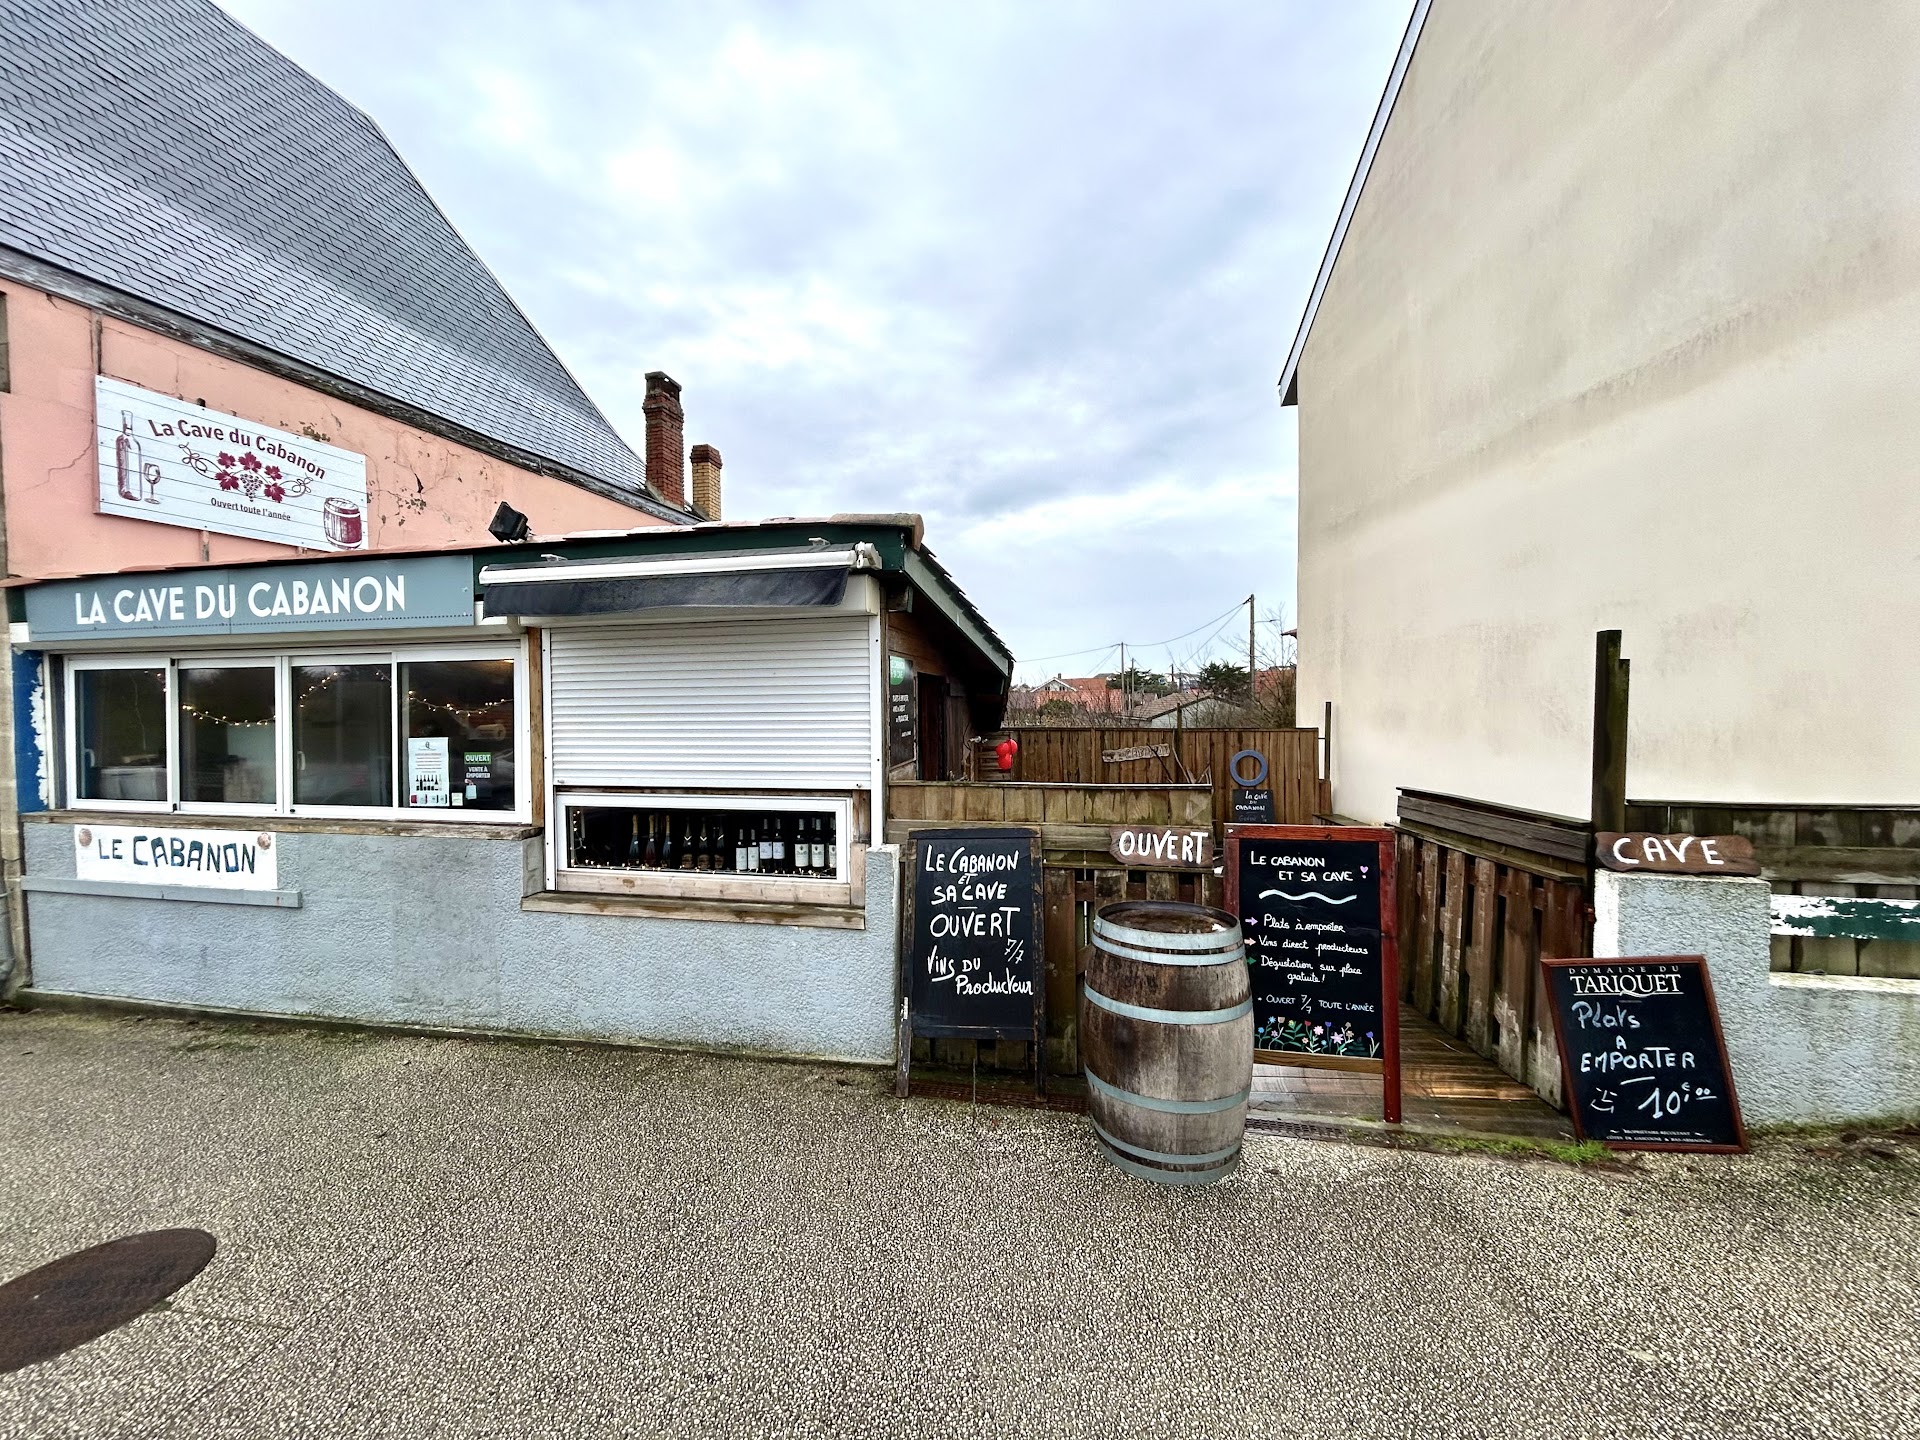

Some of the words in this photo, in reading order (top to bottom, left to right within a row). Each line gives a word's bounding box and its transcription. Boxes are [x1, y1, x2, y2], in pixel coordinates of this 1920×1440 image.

[148, 419, 174, 437] La
[178, 420, 224, 440] Cave
[229, 428, 250, 446] du
[256, 436, 326, 480] Cabanon
[211, 498, 239, 511] Ouvert
[240, 502, 261, 516] toute
[262, 502, 291, 521] l'année
[75, 593, 106, 625] LA
[114, 587, 184, 623] CAVE
[196, 584, 236, 619] DU
[248, 575, 406, 618] CABANON
[98, 838, 122, 862] LE
[132, 835, 256, 874] CABANON
[925, 844, 945, 872] LE
[948, 847, 1019, 874] CABANON
[1118, 830, 1208, 864] OUVERT
[1250, 850, 1267, 866] LE
[1271, 856, 1325, 868] CABANON
[1613, 836, 1724, 864] CAVE
[958, 873, 978, 885] ET
[1278, 870, 1293, 881] ET
[1301, 870, 1316, 882] SA
[1322, 871, 1353, 882] CAVE
[931, 885, 956, 906] SA
[962, 880, 1008, 901] CAVE
[930, 906, 1020, 938] OUVERT
[1264, 913, 1290, 930] Plats
[1295, 918, 1303, 930] à
[1305, 922, 1346, 935] emporter
[1004, 938, 1025, 964] 7/7
[1258, 935, 1278, 947] Vins
[1282, 939, 1309, 950] direct
[1315, 943, 1368, 956] producteurs
[962, 957, 980, 972] DU
[1260, 955, 1313, 970] Dégustation
[1320, 964, 1336, 972] sur
[1339, 963, 1362, 977] place
[1569, 966, 1646, 974] DOMAINE
[955, 967, 1034, 996] Producteur
[1570, 974, 1681, 996] TARIQUET
[1266, 994, 1296, 1004] OUVERT
[1301, 994, 1312, 1014] 7/7
[1318, 1000, 1342, 1010] TOUTE
[1346, 1002, 1374, 1012] L'ANNÉE
[1571, 1001, 1640, 1029] Plats
[1581, 1047, 1696, 1073] EMPORTER
